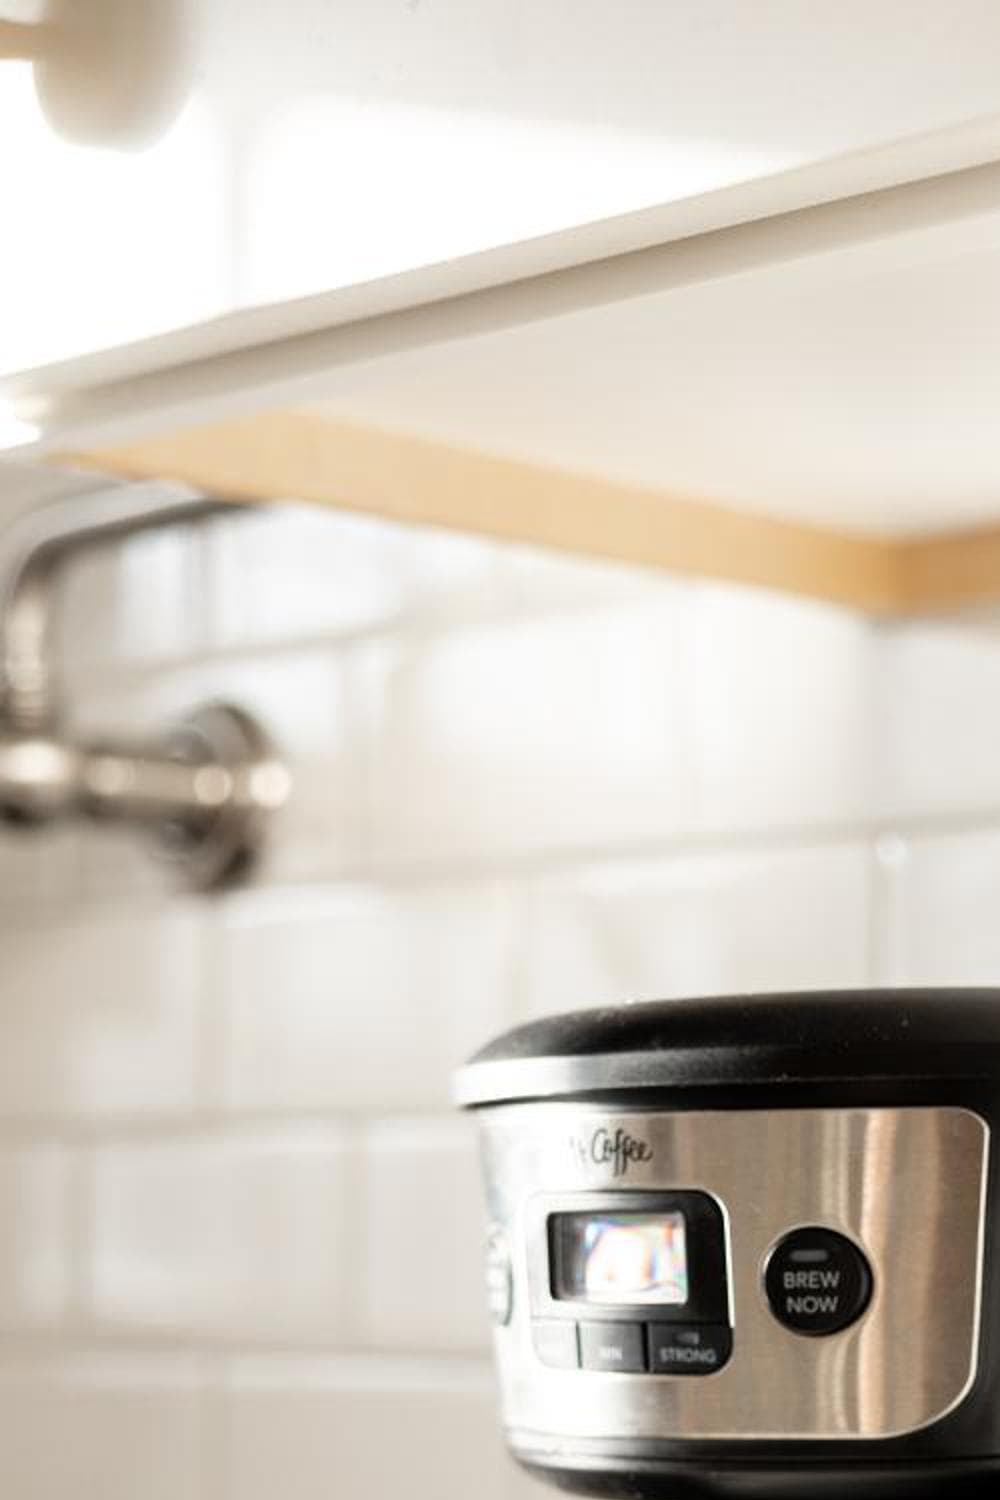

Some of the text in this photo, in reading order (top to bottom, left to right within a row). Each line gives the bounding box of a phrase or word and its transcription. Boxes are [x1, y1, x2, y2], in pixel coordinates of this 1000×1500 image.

[592, 1129, 653, 1177] Coffee
[783, 1270, 840, 1290] BREW
[786, 1297, 839, 1313] NOW
[659, 1348, 716, 1364] STRONG
